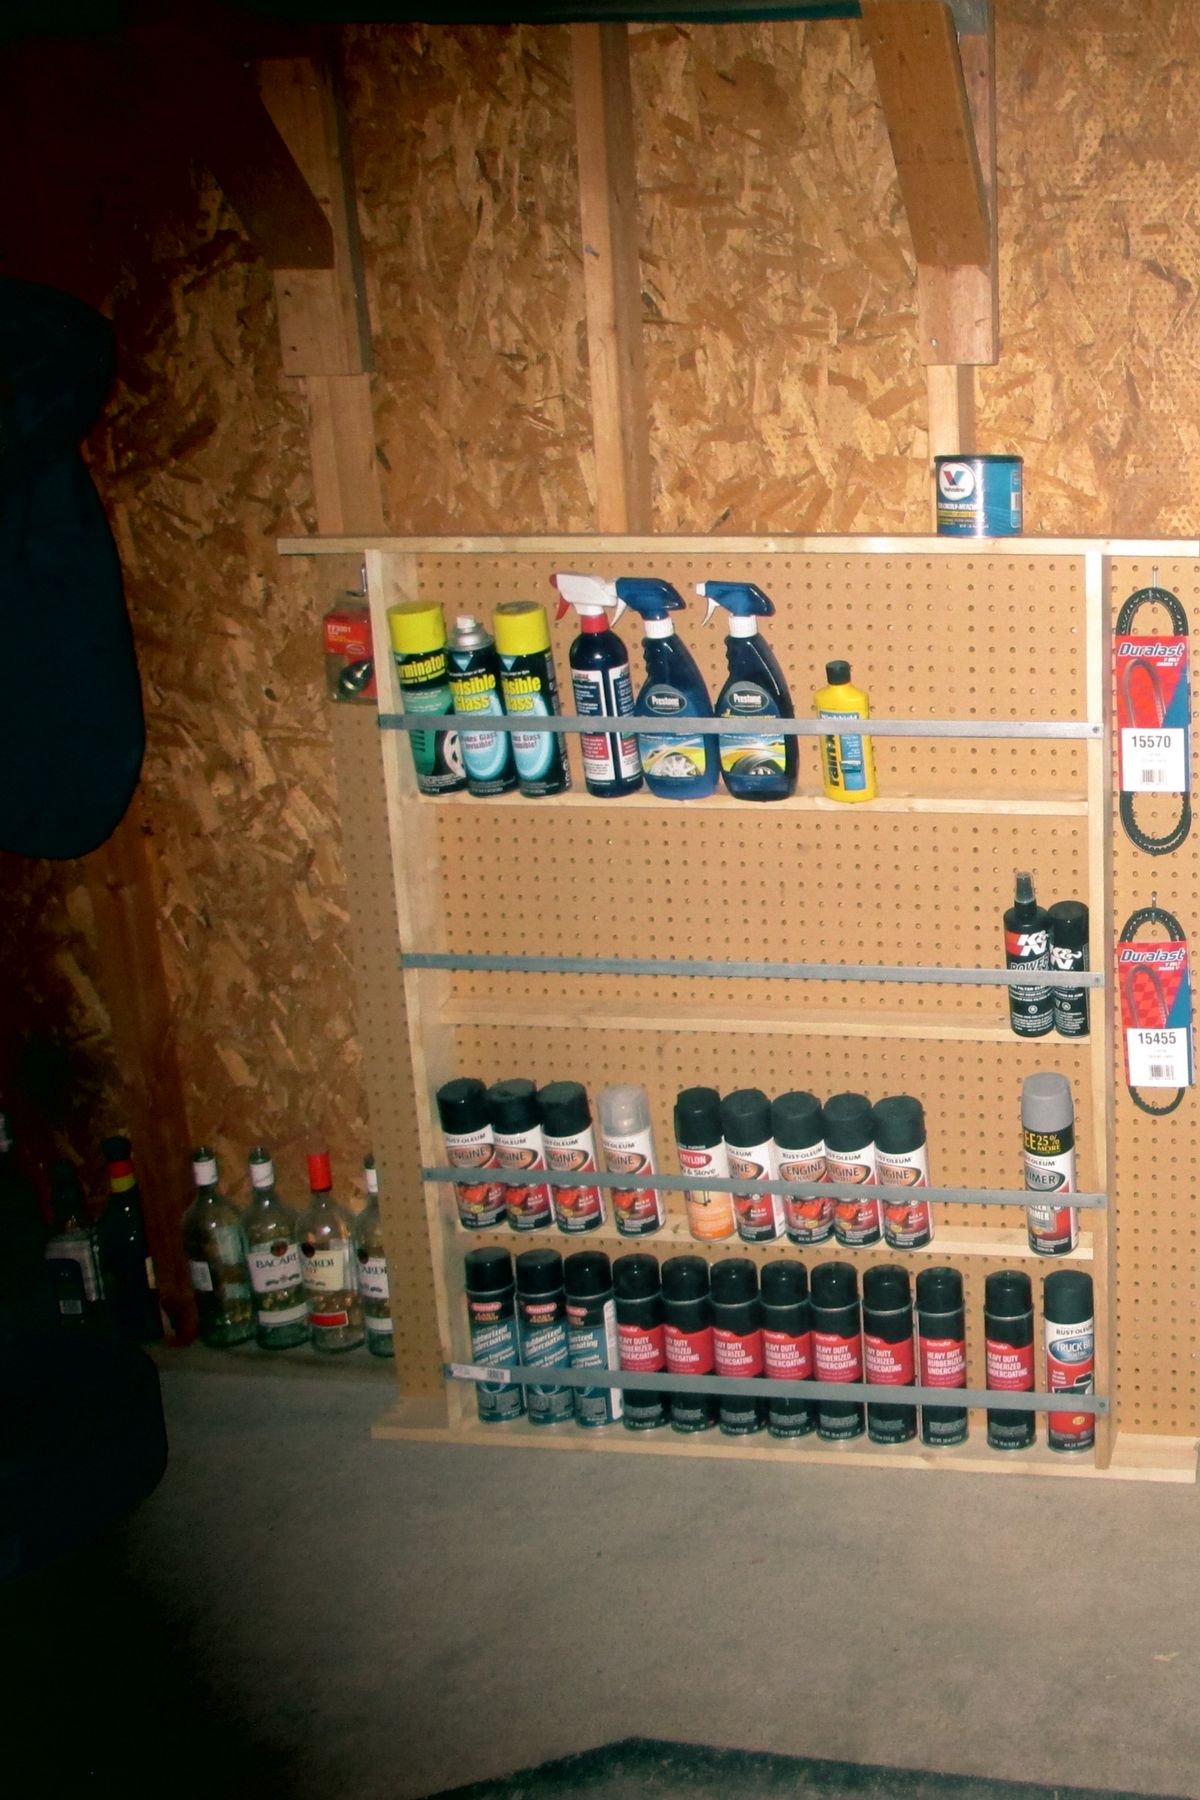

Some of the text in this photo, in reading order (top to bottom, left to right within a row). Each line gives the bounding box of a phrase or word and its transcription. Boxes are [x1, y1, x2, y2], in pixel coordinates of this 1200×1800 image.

[1117, 642, 1185, 657] Duralast
[399, 653, 446, 680] rminator
[450, 673, 496, 697] visible
[733, 693, 762, 705] Prestone
[1131, 735, 1172, 748] 15570
[1119, 947, 1185, 963] Duralast
[1137, 1032, 1176, 1045] 15455
[446, 1132, 486, 1144] UST-OLEUM
[1036, 1133, 1060, 1147] 25%
[782, 1146, 823, 1159] RUST-OLEUM
[786, 1160, 823, 1177] ENGINE
[829, 1165, 860, 1177] NGINE
[880, 1167, 910, 1180] NGINE
[1028, 1171, 1056, 1185] IMER
[302, 1258, 335, 1268] ARDI
[360, 1264, 388, 1275] ARDI
[780, 1343, 797, 1352] DUTY
[832, 1345, 849, 1354] DUTY
[875, 1349, 892, 1357] DUTY
[1056, 1342, 1082, 1353] TRUCK
[926, 1348, 960, 1360] HEAVY DUTY
[1002, 1354, 1019, 1362] DUTY
